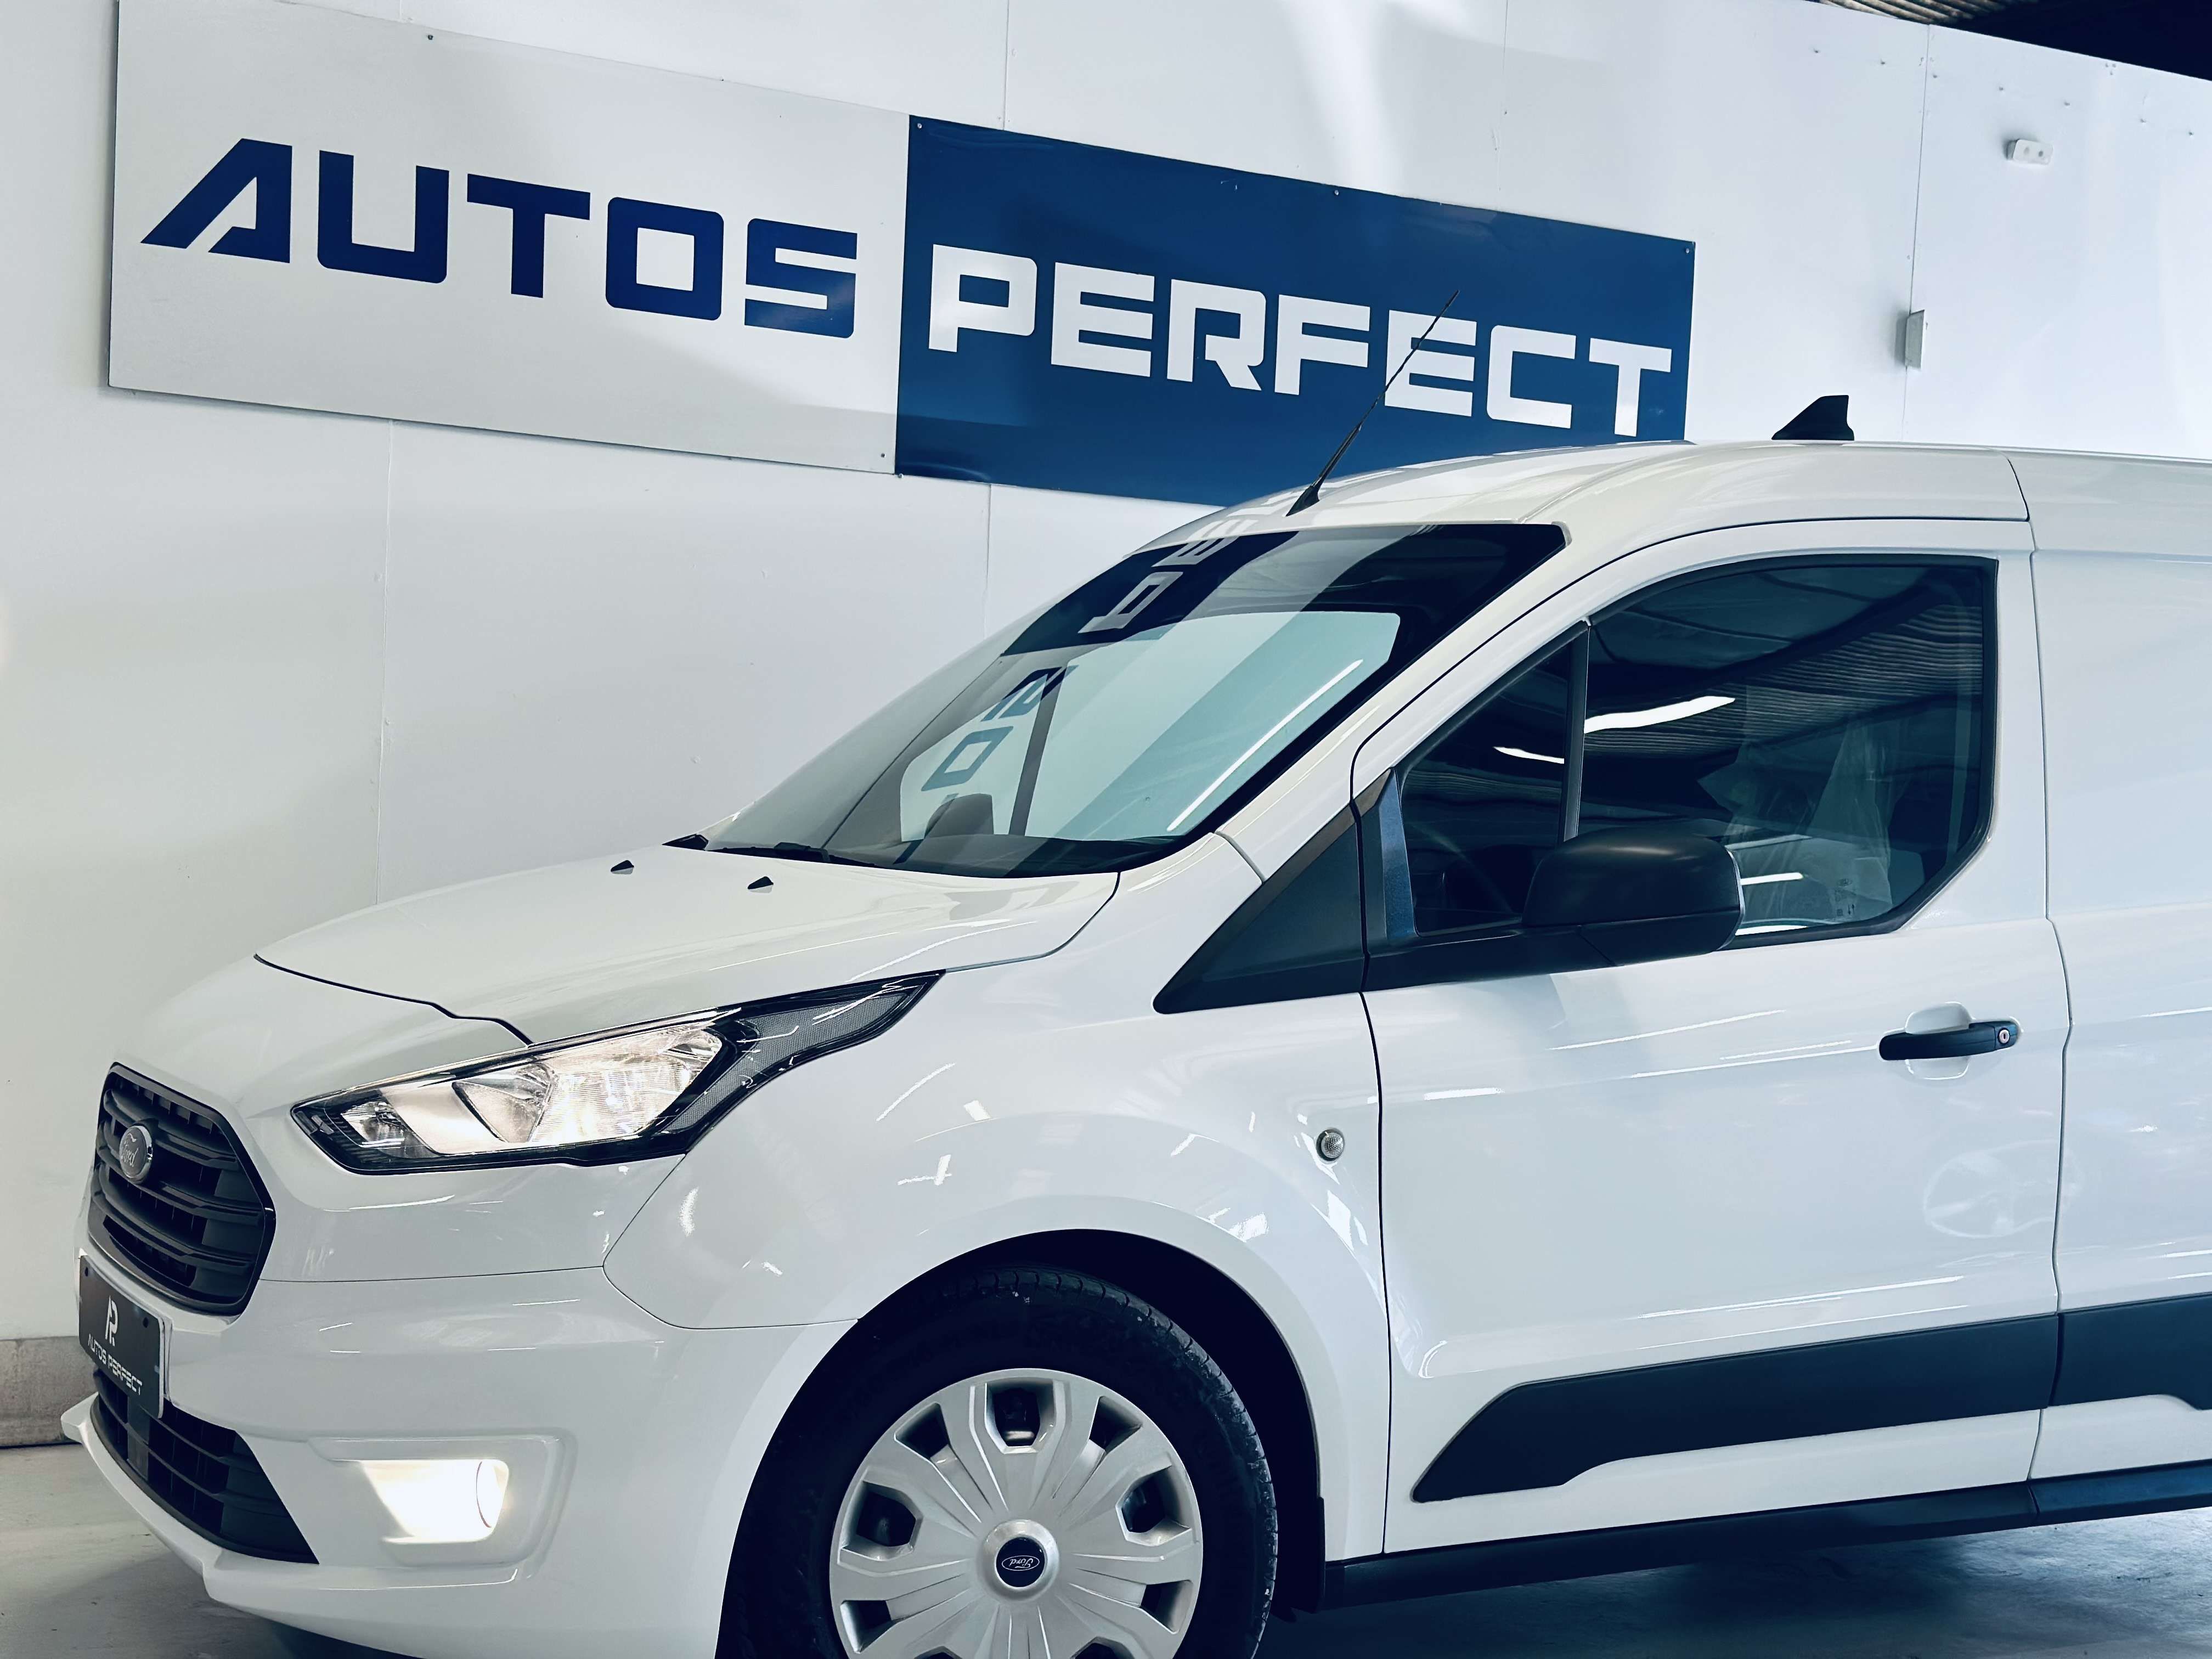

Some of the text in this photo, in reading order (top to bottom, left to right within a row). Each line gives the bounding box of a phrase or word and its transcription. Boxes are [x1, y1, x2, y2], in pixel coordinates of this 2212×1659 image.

[140, 138, 1672, 437] AUTOS PERFECT
[88, 1333, 143, 1396] AUTOS PERFECT
[1008, 1558, 1034, 1569] Ford
